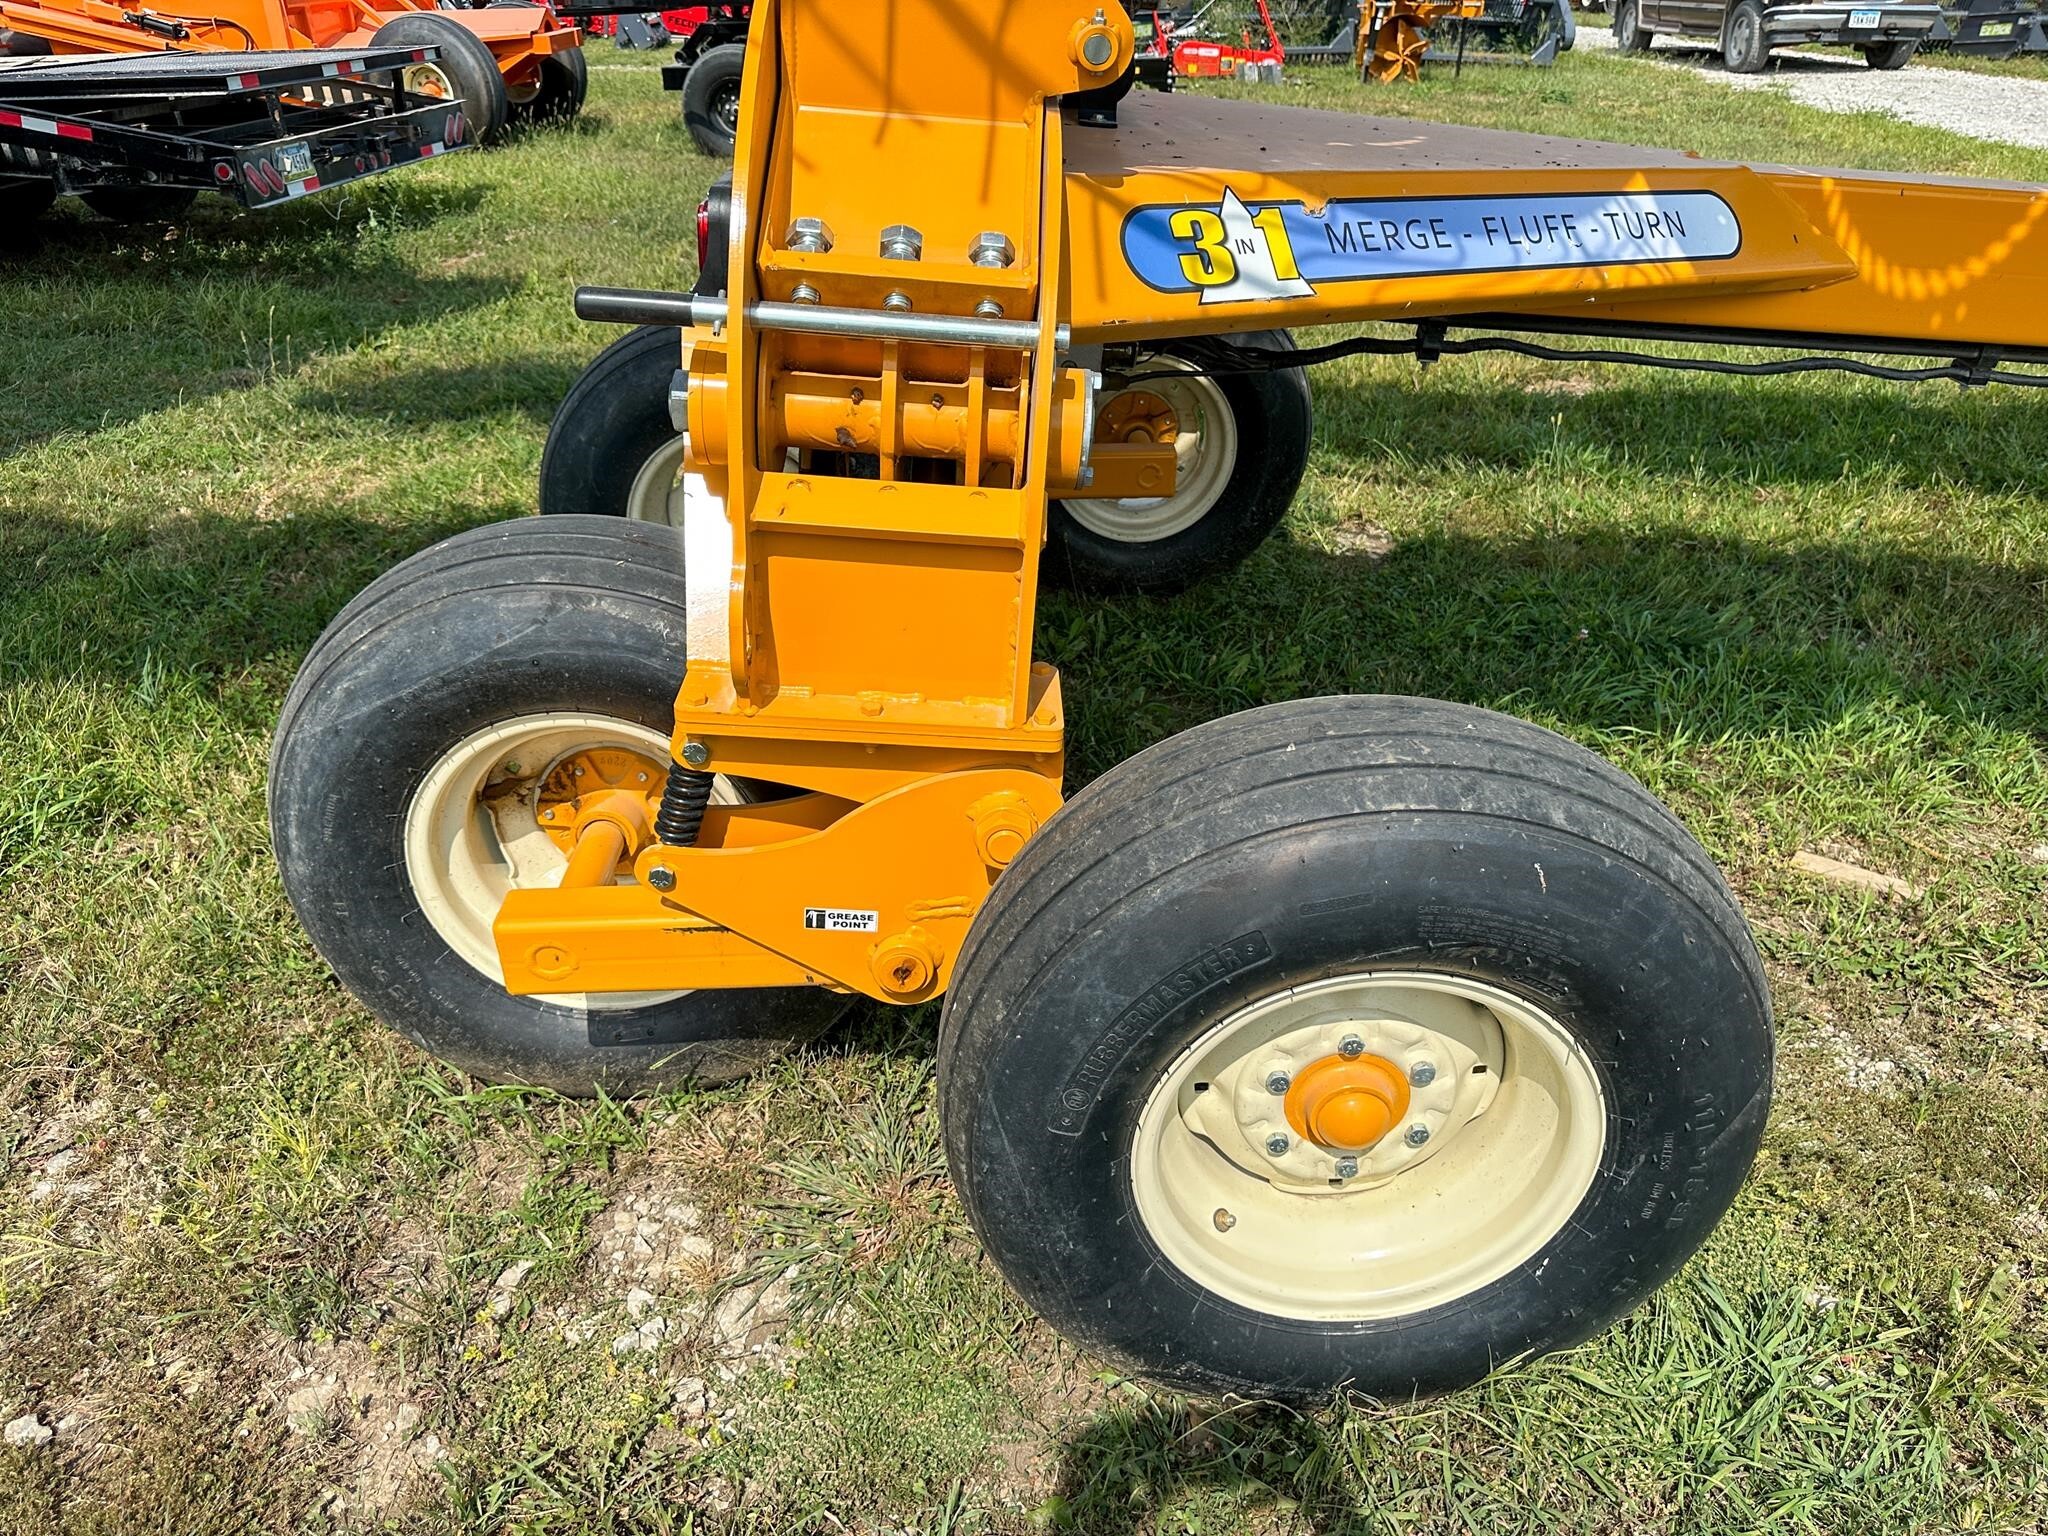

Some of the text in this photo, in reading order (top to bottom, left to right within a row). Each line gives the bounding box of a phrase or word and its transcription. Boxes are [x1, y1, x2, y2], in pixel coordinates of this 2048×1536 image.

[1168, 207, 1301, 287] 3 IN 1
[1324, 217, 1452, 254] MERGE
[1481, 213, 1577, 247] FLUFF
[1602, 210, 1687, 240] TURN
[828, 912, 875, 922] GREASE
[833, 921, 869, 929] POINT
[1076, 946, 1243, 1088] RUBBERMASTER
